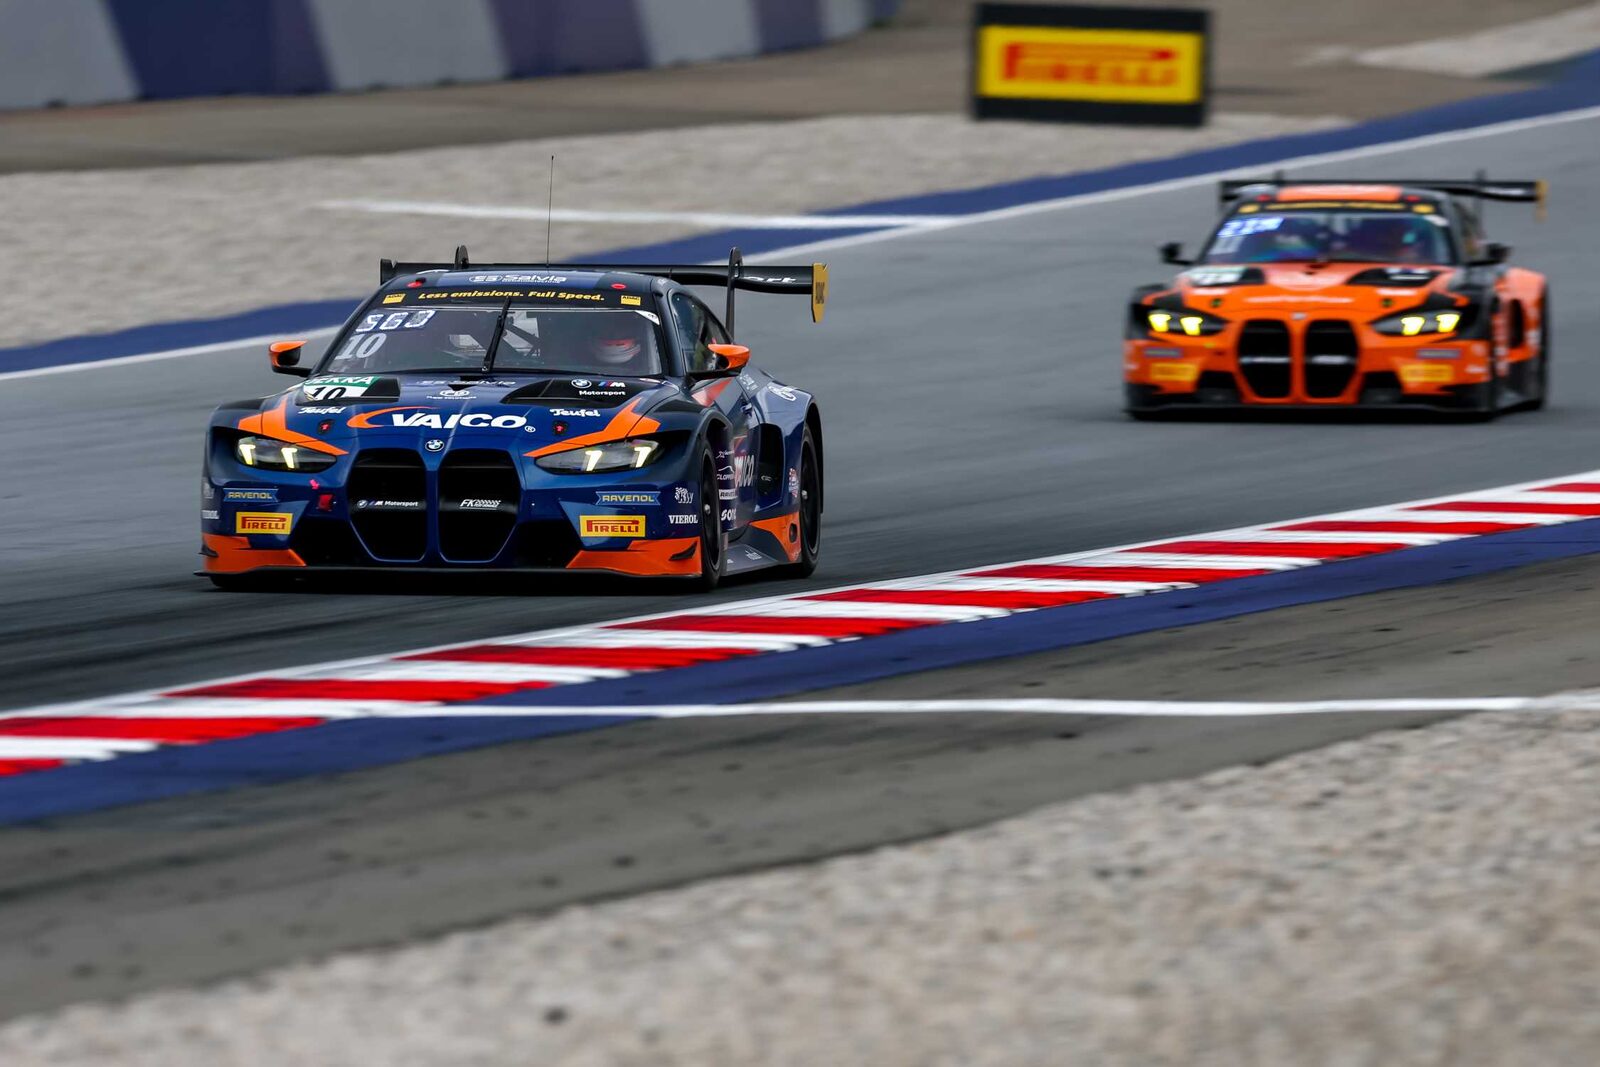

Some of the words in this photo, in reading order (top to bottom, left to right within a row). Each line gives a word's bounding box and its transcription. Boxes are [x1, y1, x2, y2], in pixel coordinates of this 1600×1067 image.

[451, 290, 524, 298] emissions.
[557, 292, 605, 301] Speed.
[339, 332, 387, 360] 10
[312, 386, 347, 400] 10
[298, 406, 347, 415] Teufel
[550, 408, 601, 418] Teufel
[391, 413, 527, 429] VAICO
[227, 491, 273, 499] RAVENOL
[602, 494, 655, 503] RAVENOL
[241, 516, 287, 530] PIRELLI
[668, 514, 699, 525] VIEROL
[586, 519, 640, 533] PIRELLI
